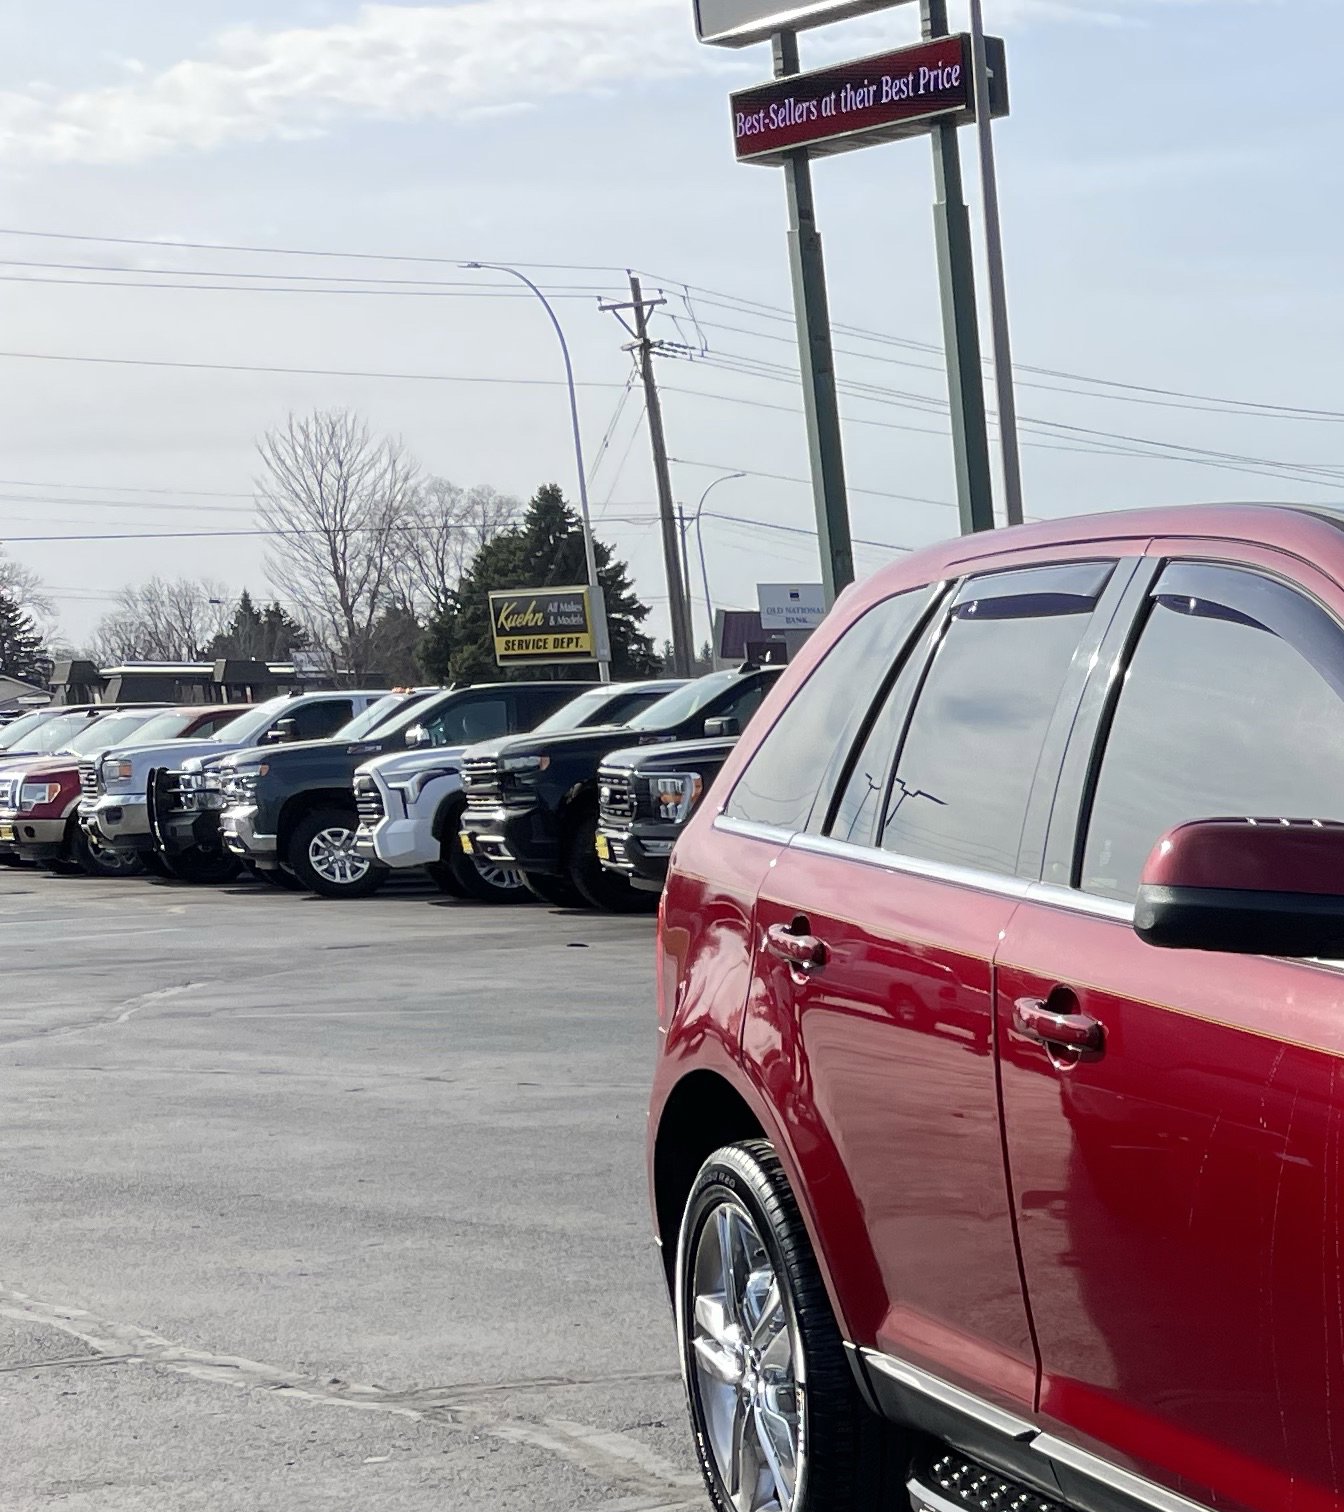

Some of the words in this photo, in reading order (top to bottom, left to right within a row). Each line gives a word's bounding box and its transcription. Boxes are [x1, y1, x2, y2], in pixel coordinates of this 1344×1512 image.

[735, 98, 817, 137] Best-Sellers
[821, 94, 837, 118] at
[840, 80, 877, 113] their
[880, 76, 914, 104] Best
[917, 60, 961, 95] Price
[547, 602, 559, 612] All
[560, 600, 583, 612] Makes
[766, 606, 784, 615] OLD
[497, 599, 545, 632] Kuehn
[557, 614, 584, 626] Models
[785, 616, 808, 624] BANK
[504, 637, 549, 651] SERVICE
[552, 636, 584, 650] DEPT.
